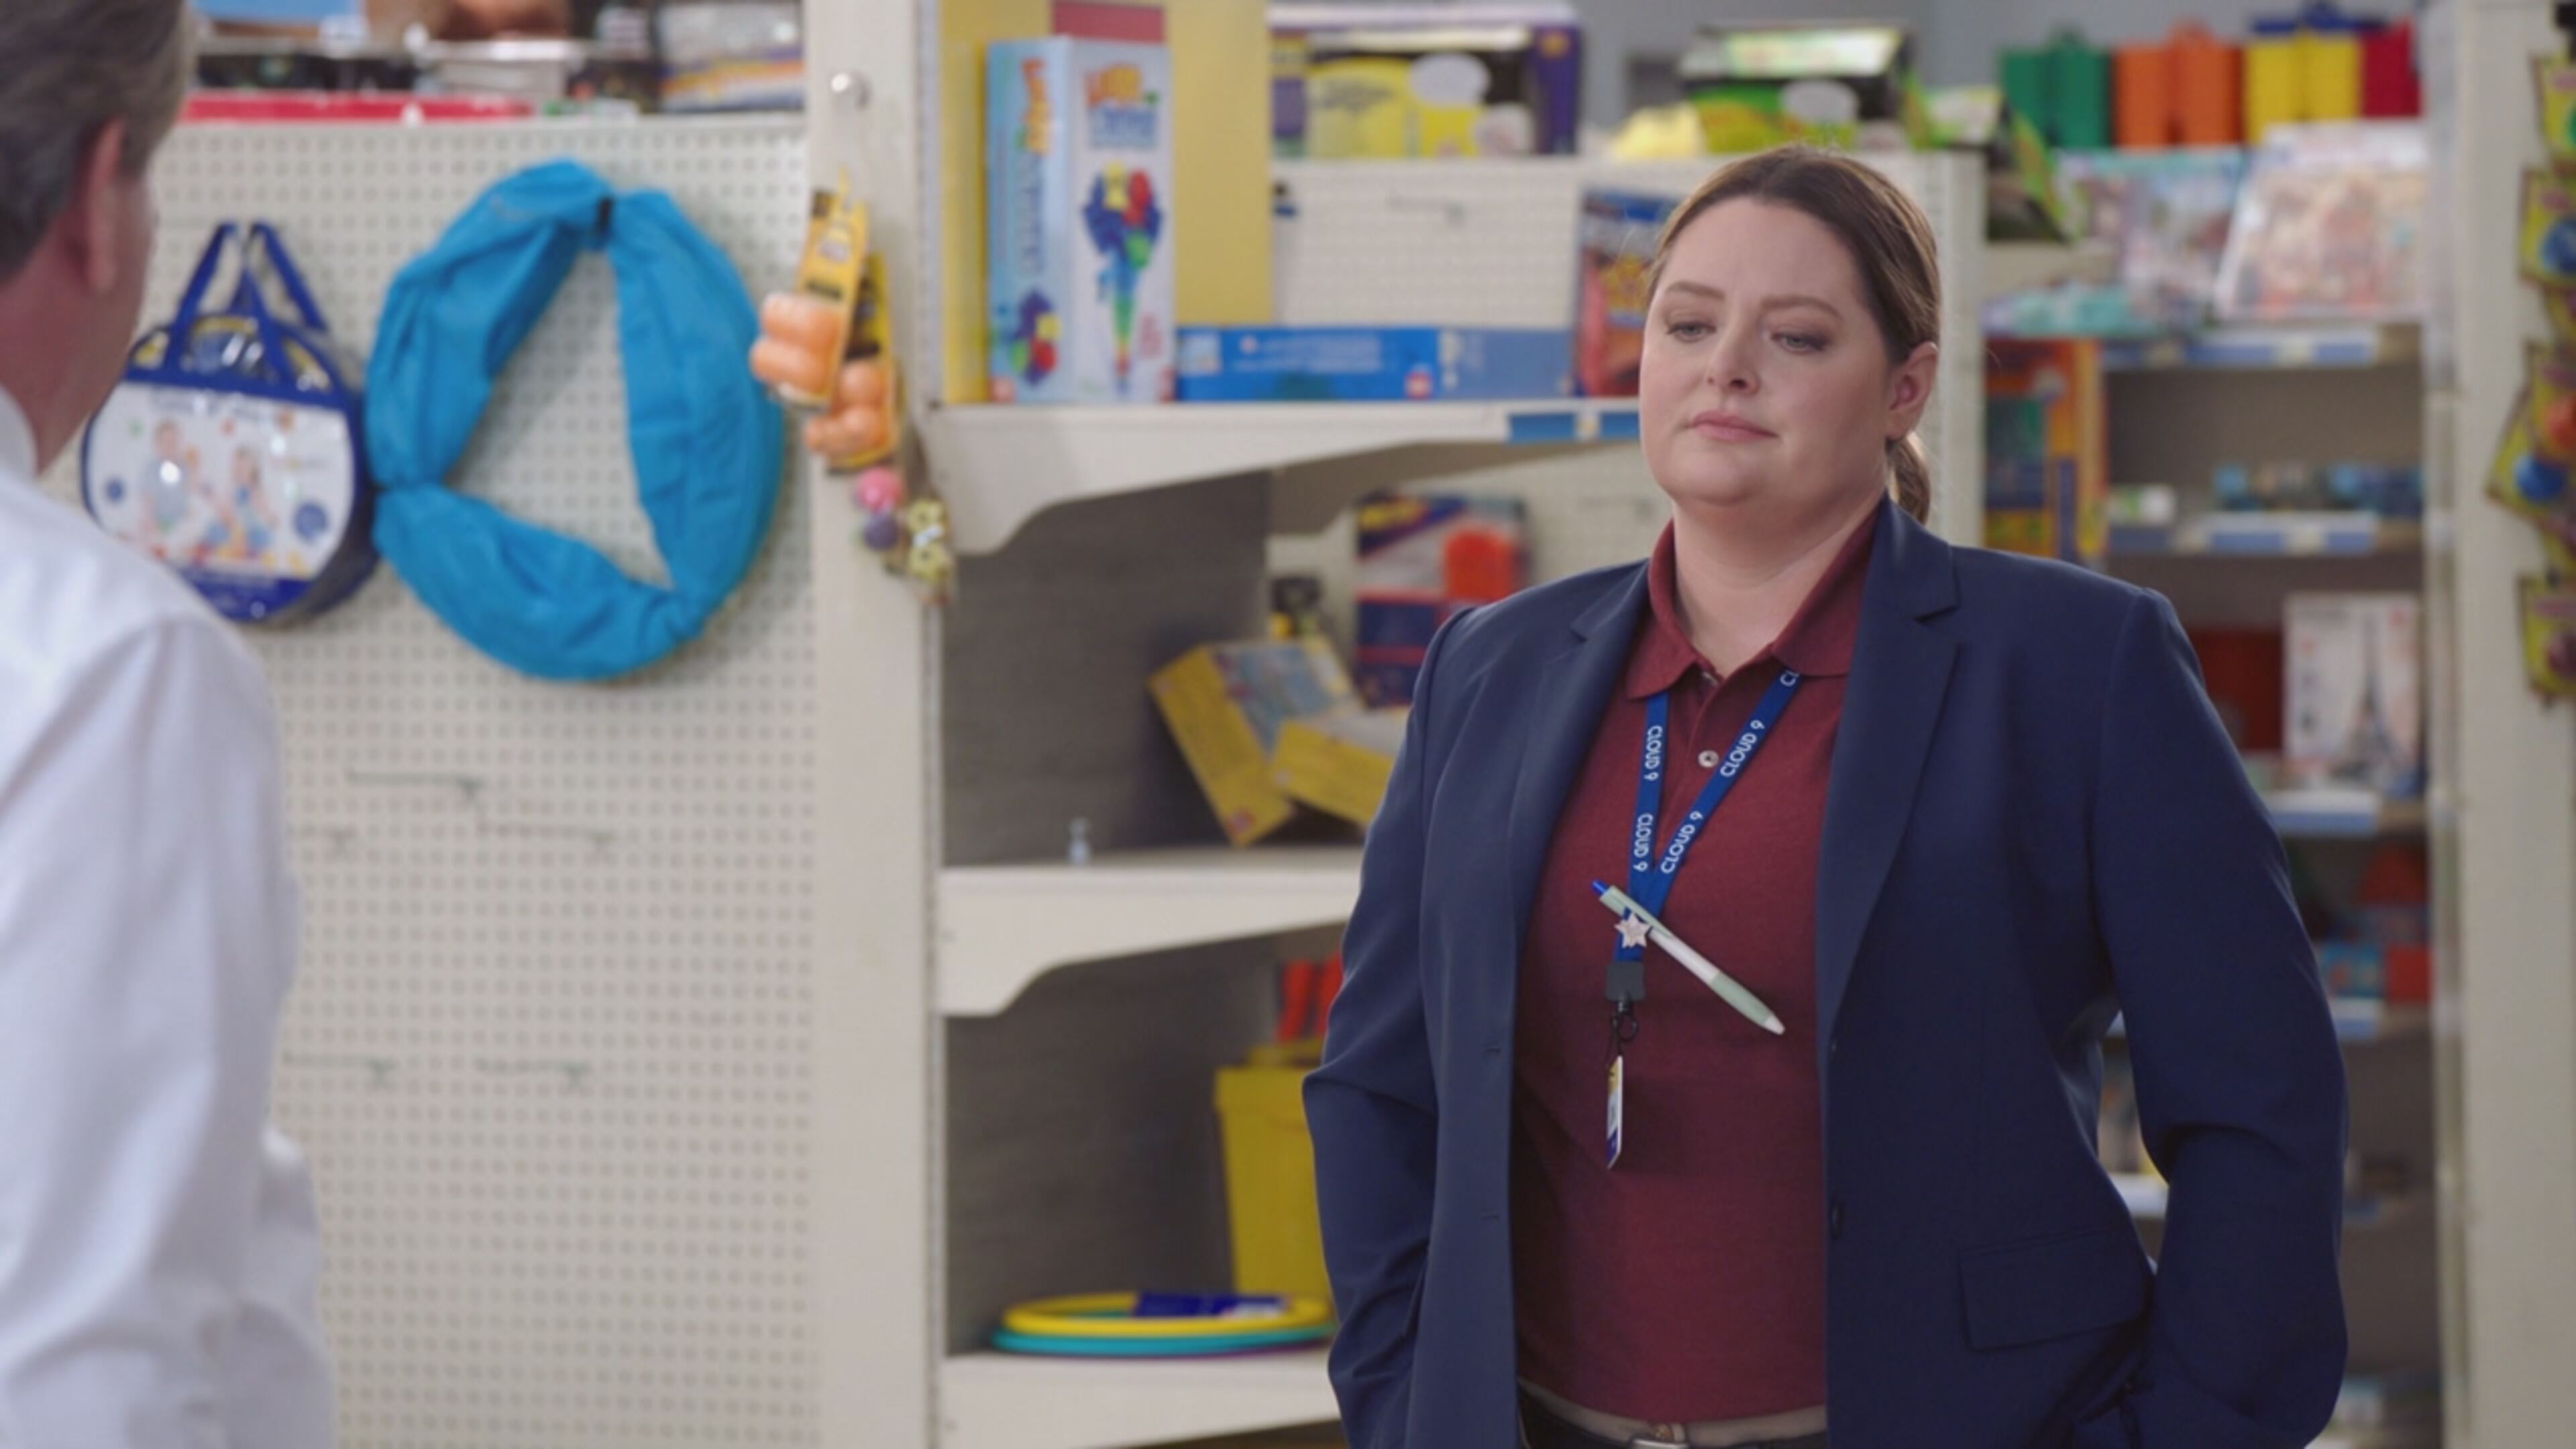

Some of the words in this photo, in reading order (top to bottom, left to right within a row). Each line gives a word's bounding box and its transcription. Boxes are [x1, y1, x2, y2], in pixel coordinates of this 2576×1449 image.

[1646, 725, 1663, 769] CLOUD
[1720, 733, 1757, 777] CLOUD
[1750, 720, 1765, 730] 9
[1644, 771, 1659, 781] 9
[1633, 812, 1654, 858] CLOUD
[1660, 824, 1696, 874] CLOUD
[1689, 810, 1703, 820] 9
[1633, 861, 1648, 872] 9
